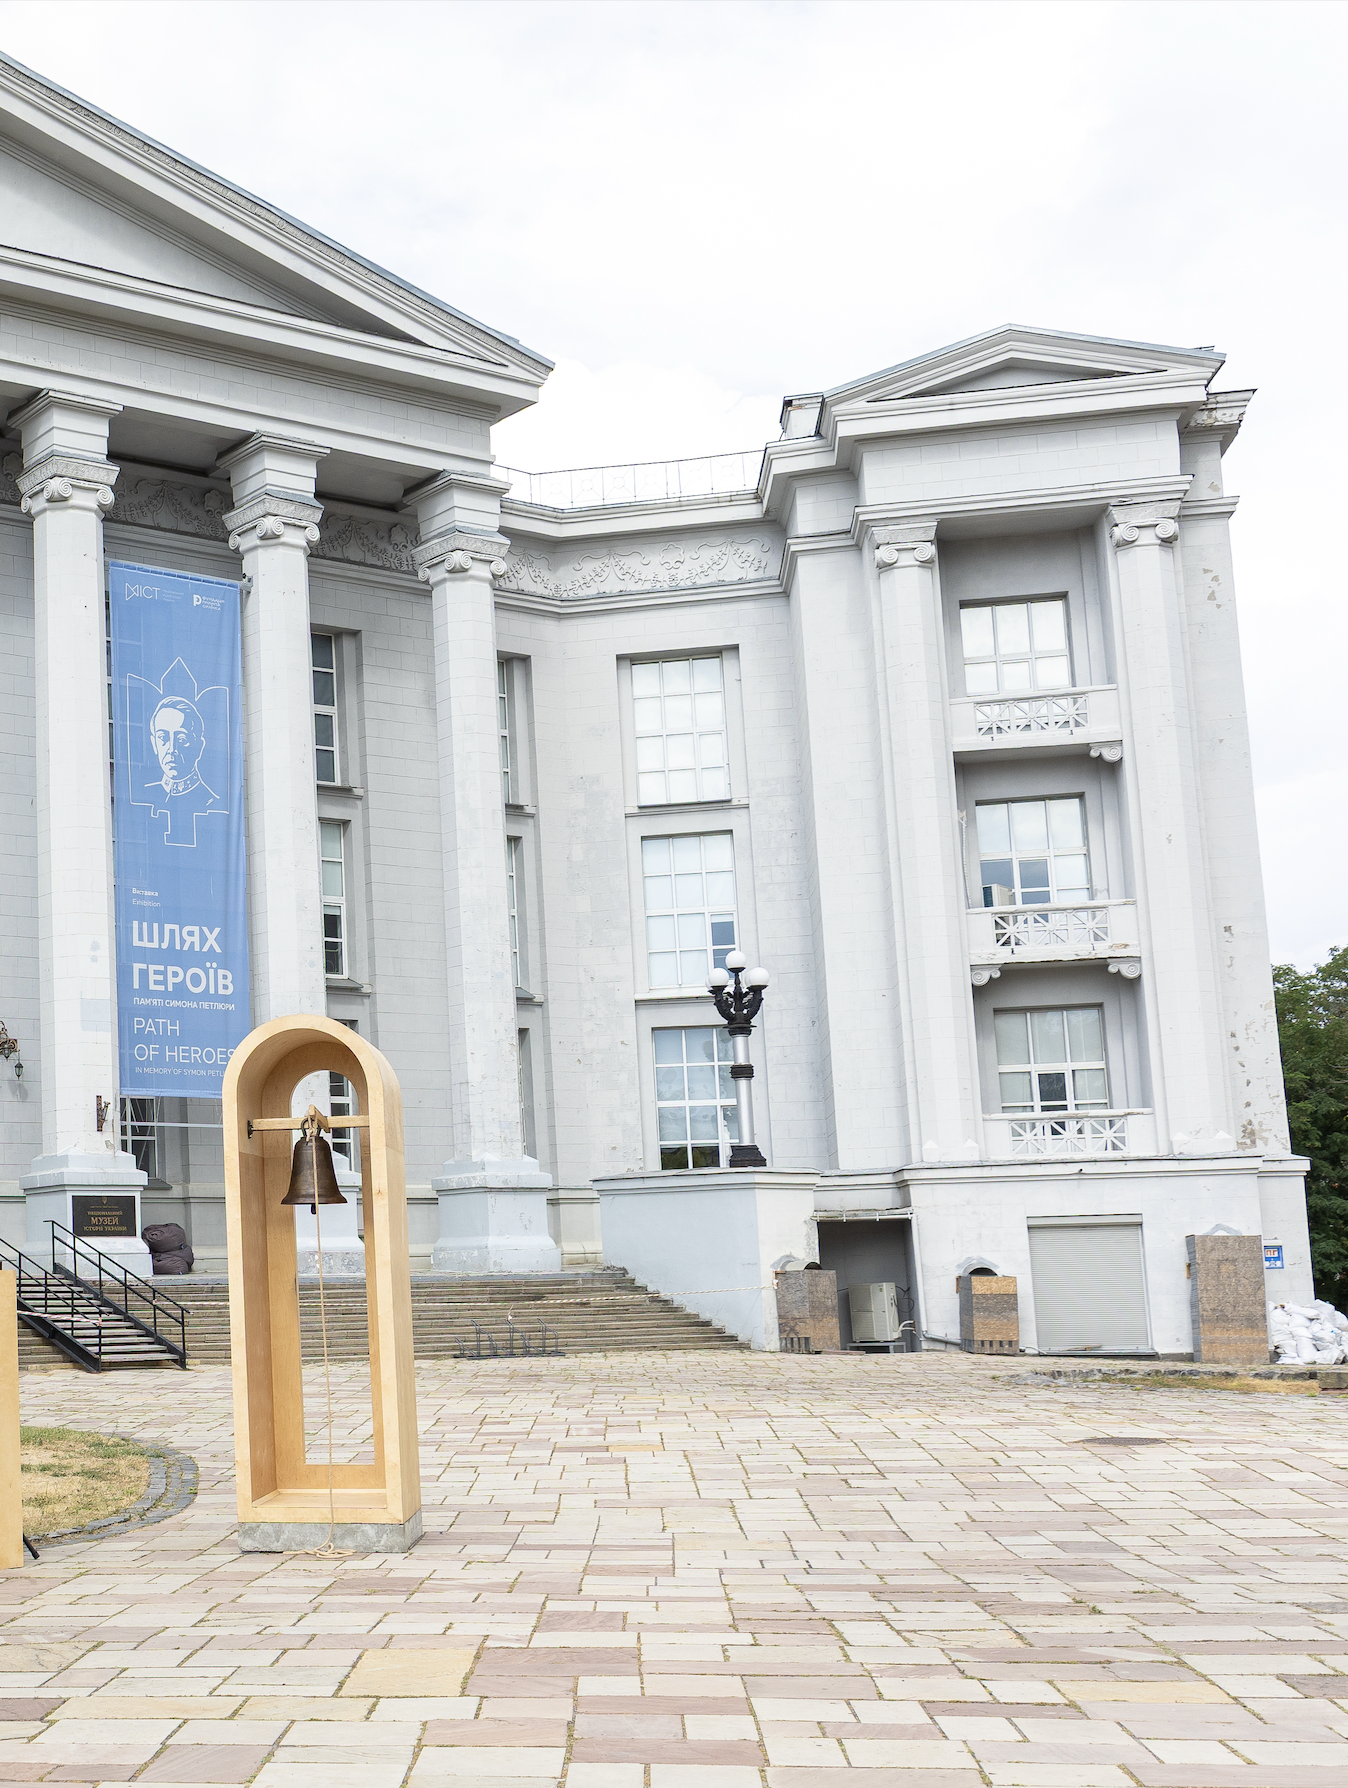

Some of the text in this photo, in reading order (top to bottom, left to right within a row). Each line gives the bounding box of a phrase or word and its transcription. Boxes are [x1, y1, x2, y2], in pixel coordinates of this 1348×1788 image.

[132, 887, 159, 897] Виставка
[132, 899, 161, 908] Exhibition
[132, 920, 222, 953] ШЛЯХ
[132, 961, 234, 996] ГЕРОЇВ
[133, 997, 235, 1011] ПАМ'ЯТІ СИМОНА ПЕТЛЮРИ
[134, 1017, 180, 1037] PATH
[134, 1044, 160, 1062] OF
[143, 1067, 173, 1075] MEMORY
[90, 1216, 119, 1225] МУЗЕЙ
